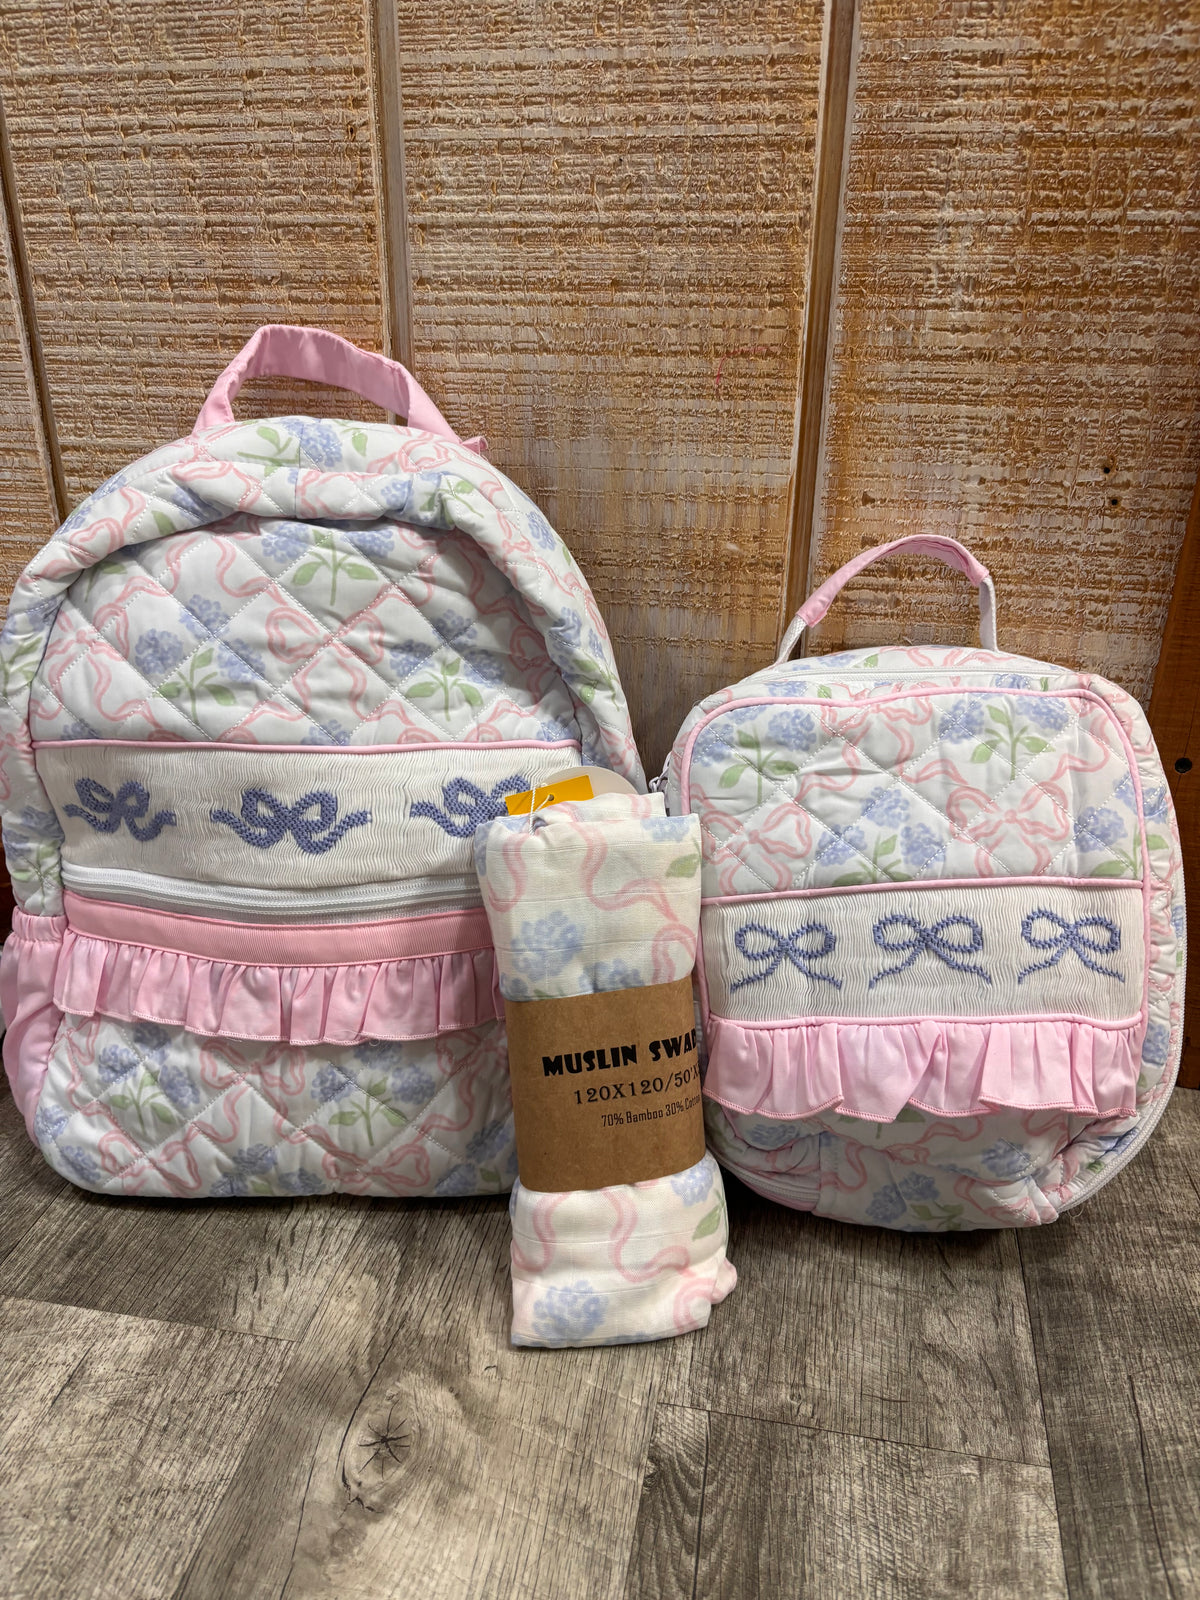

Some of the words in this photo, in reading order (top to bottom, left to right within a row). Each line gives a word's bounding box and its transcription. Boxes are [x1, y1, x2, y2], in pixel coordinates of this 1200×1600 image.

[542, 1045, 637, 1076] MUSLIN
[574, 1063, 700, 1104] 120X120/50'X
[601, 1113, 624, 1127] 70%
[626, 1108, 664, 1124] Bamboo
[665, 1101, 684, 1117] 30%
